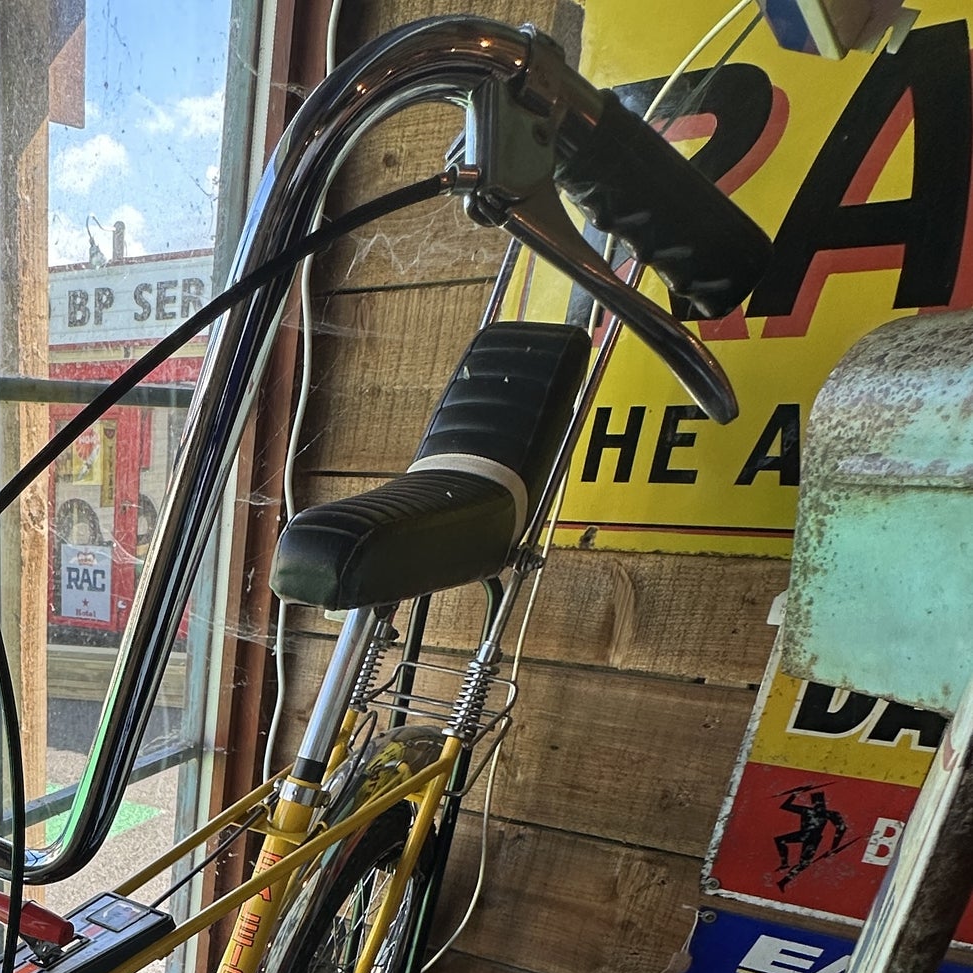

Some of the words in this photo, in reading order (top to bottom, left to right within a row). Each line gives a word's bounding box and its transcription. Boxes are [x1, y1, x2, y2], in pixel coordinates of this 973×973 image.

[68, 287, 115, 328] BP
[133, 278, 205, 322] SER
[581, 405, 710, 485] HE
[66, 567, 106, 592] RAC
